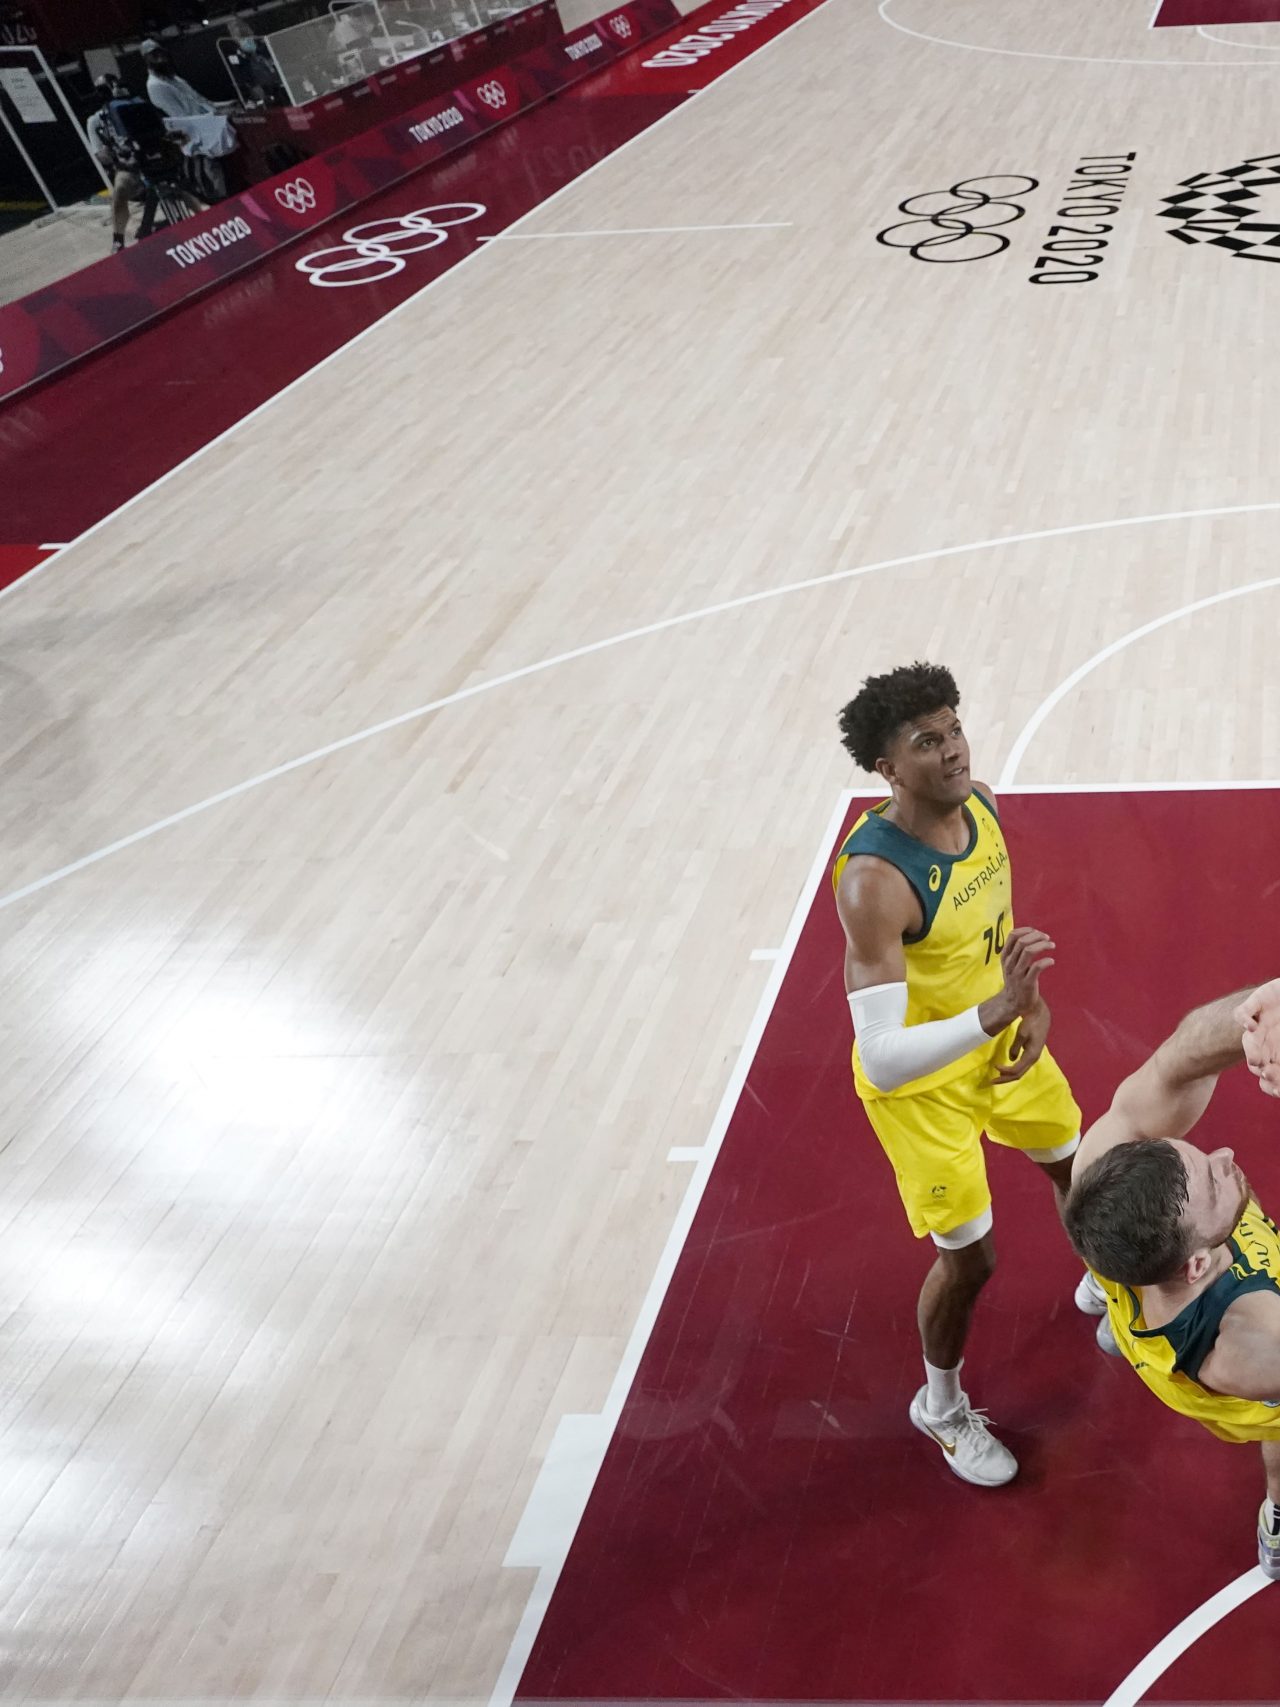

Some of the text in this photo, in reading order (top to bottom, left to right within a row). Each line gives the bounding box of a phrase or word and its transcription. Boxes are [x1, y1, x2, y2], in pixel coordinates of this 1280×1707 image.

[641, 33, 735, 68] 2020
[409, 106, 464, 144] TOKYO 2020
[165, 216, 252, 269] TOKYO 2020
[1028, 152, 1137, 284] TOKYO 2020
[953, 851, 1007, 911] AUSTRALIA
